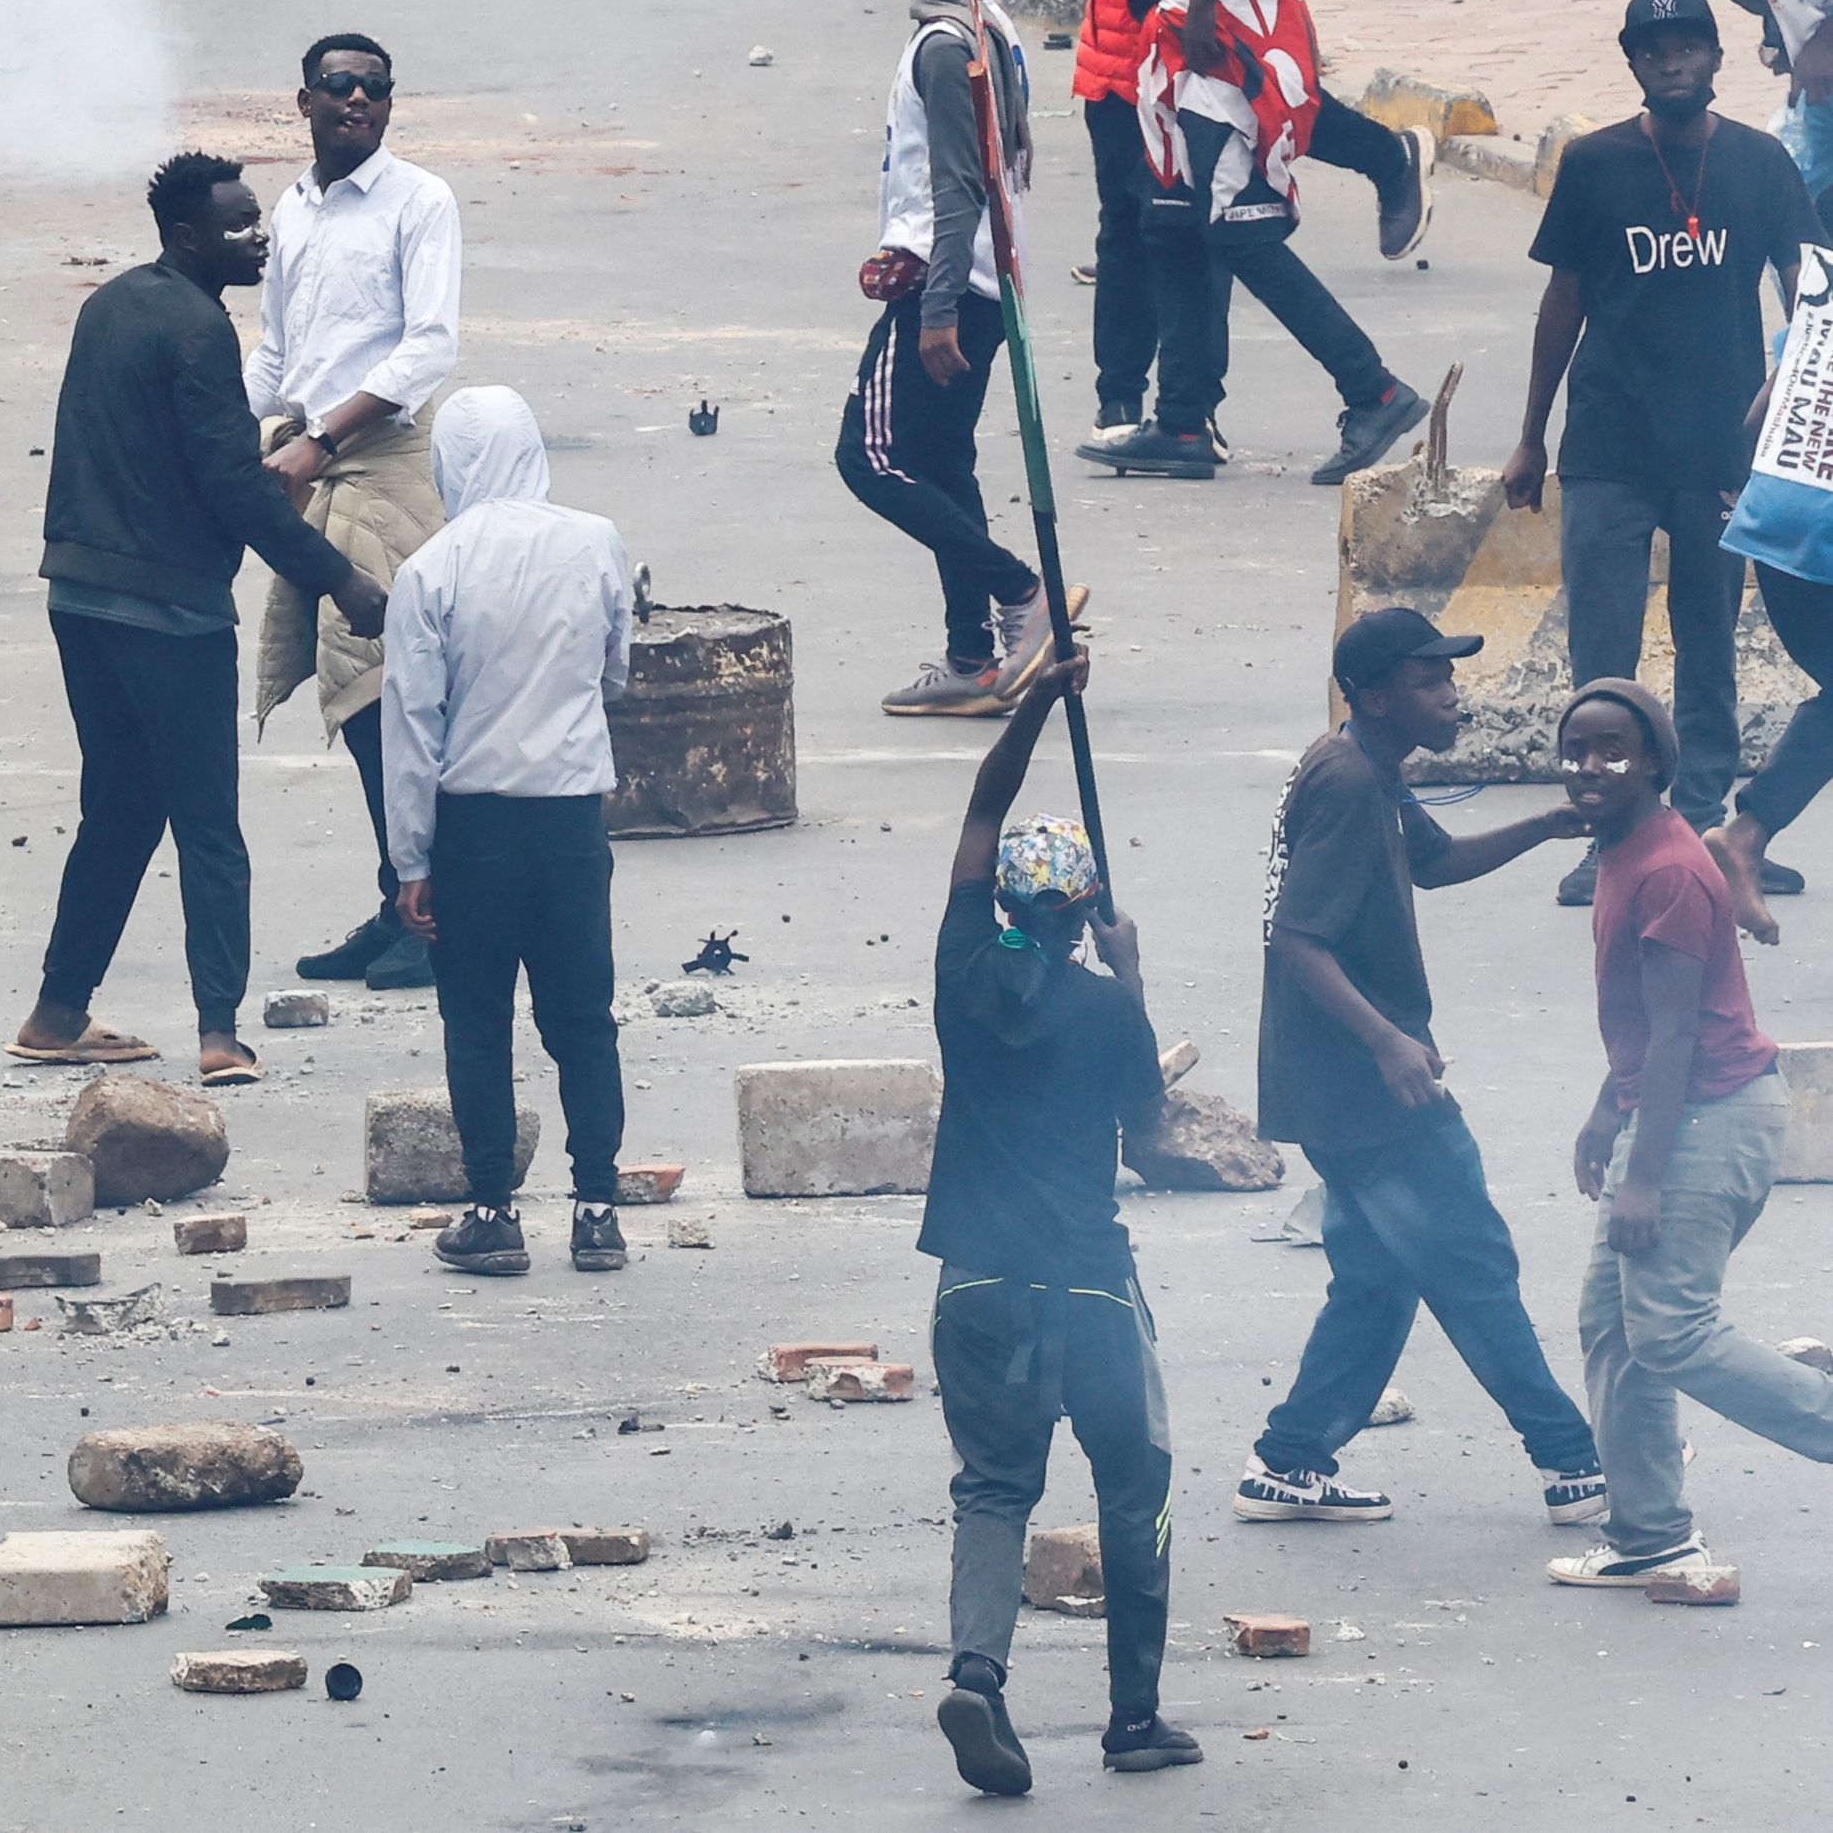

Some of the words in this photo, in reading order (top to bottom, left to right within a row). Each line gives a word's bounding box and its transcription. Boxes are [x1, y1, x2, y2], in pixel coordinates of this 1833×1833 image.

[1625, 226, 1727, 275] Drew
[1776, 397, 1812, 470] MAU
[1802, 419, 1826, 471] NEW
